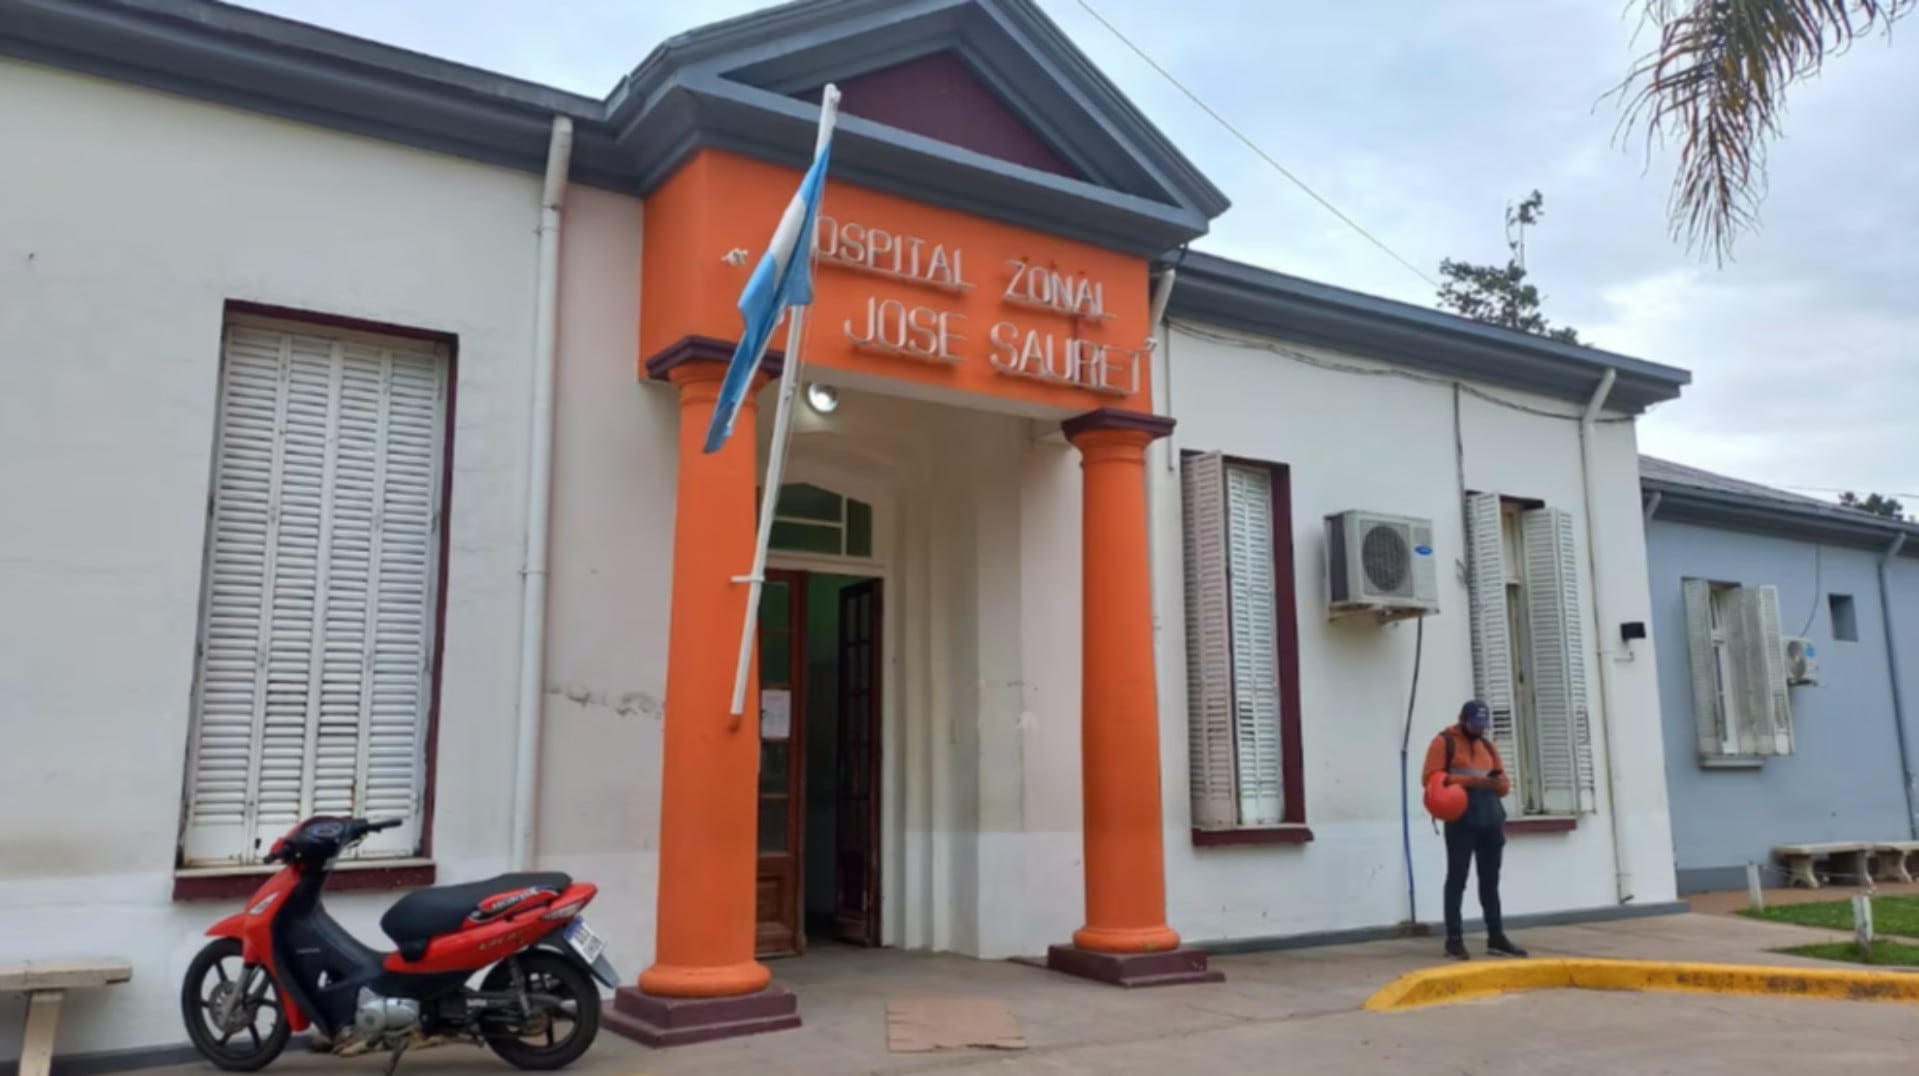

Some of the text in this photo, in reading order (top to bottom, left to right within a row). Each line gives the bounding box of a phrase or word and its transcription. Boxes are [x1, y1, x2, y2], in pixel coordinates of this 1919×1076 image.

[811, 215, 1117, 319] OSPITAL ZONAL
[844, 296, 1152, 396] JOSE SAURET
